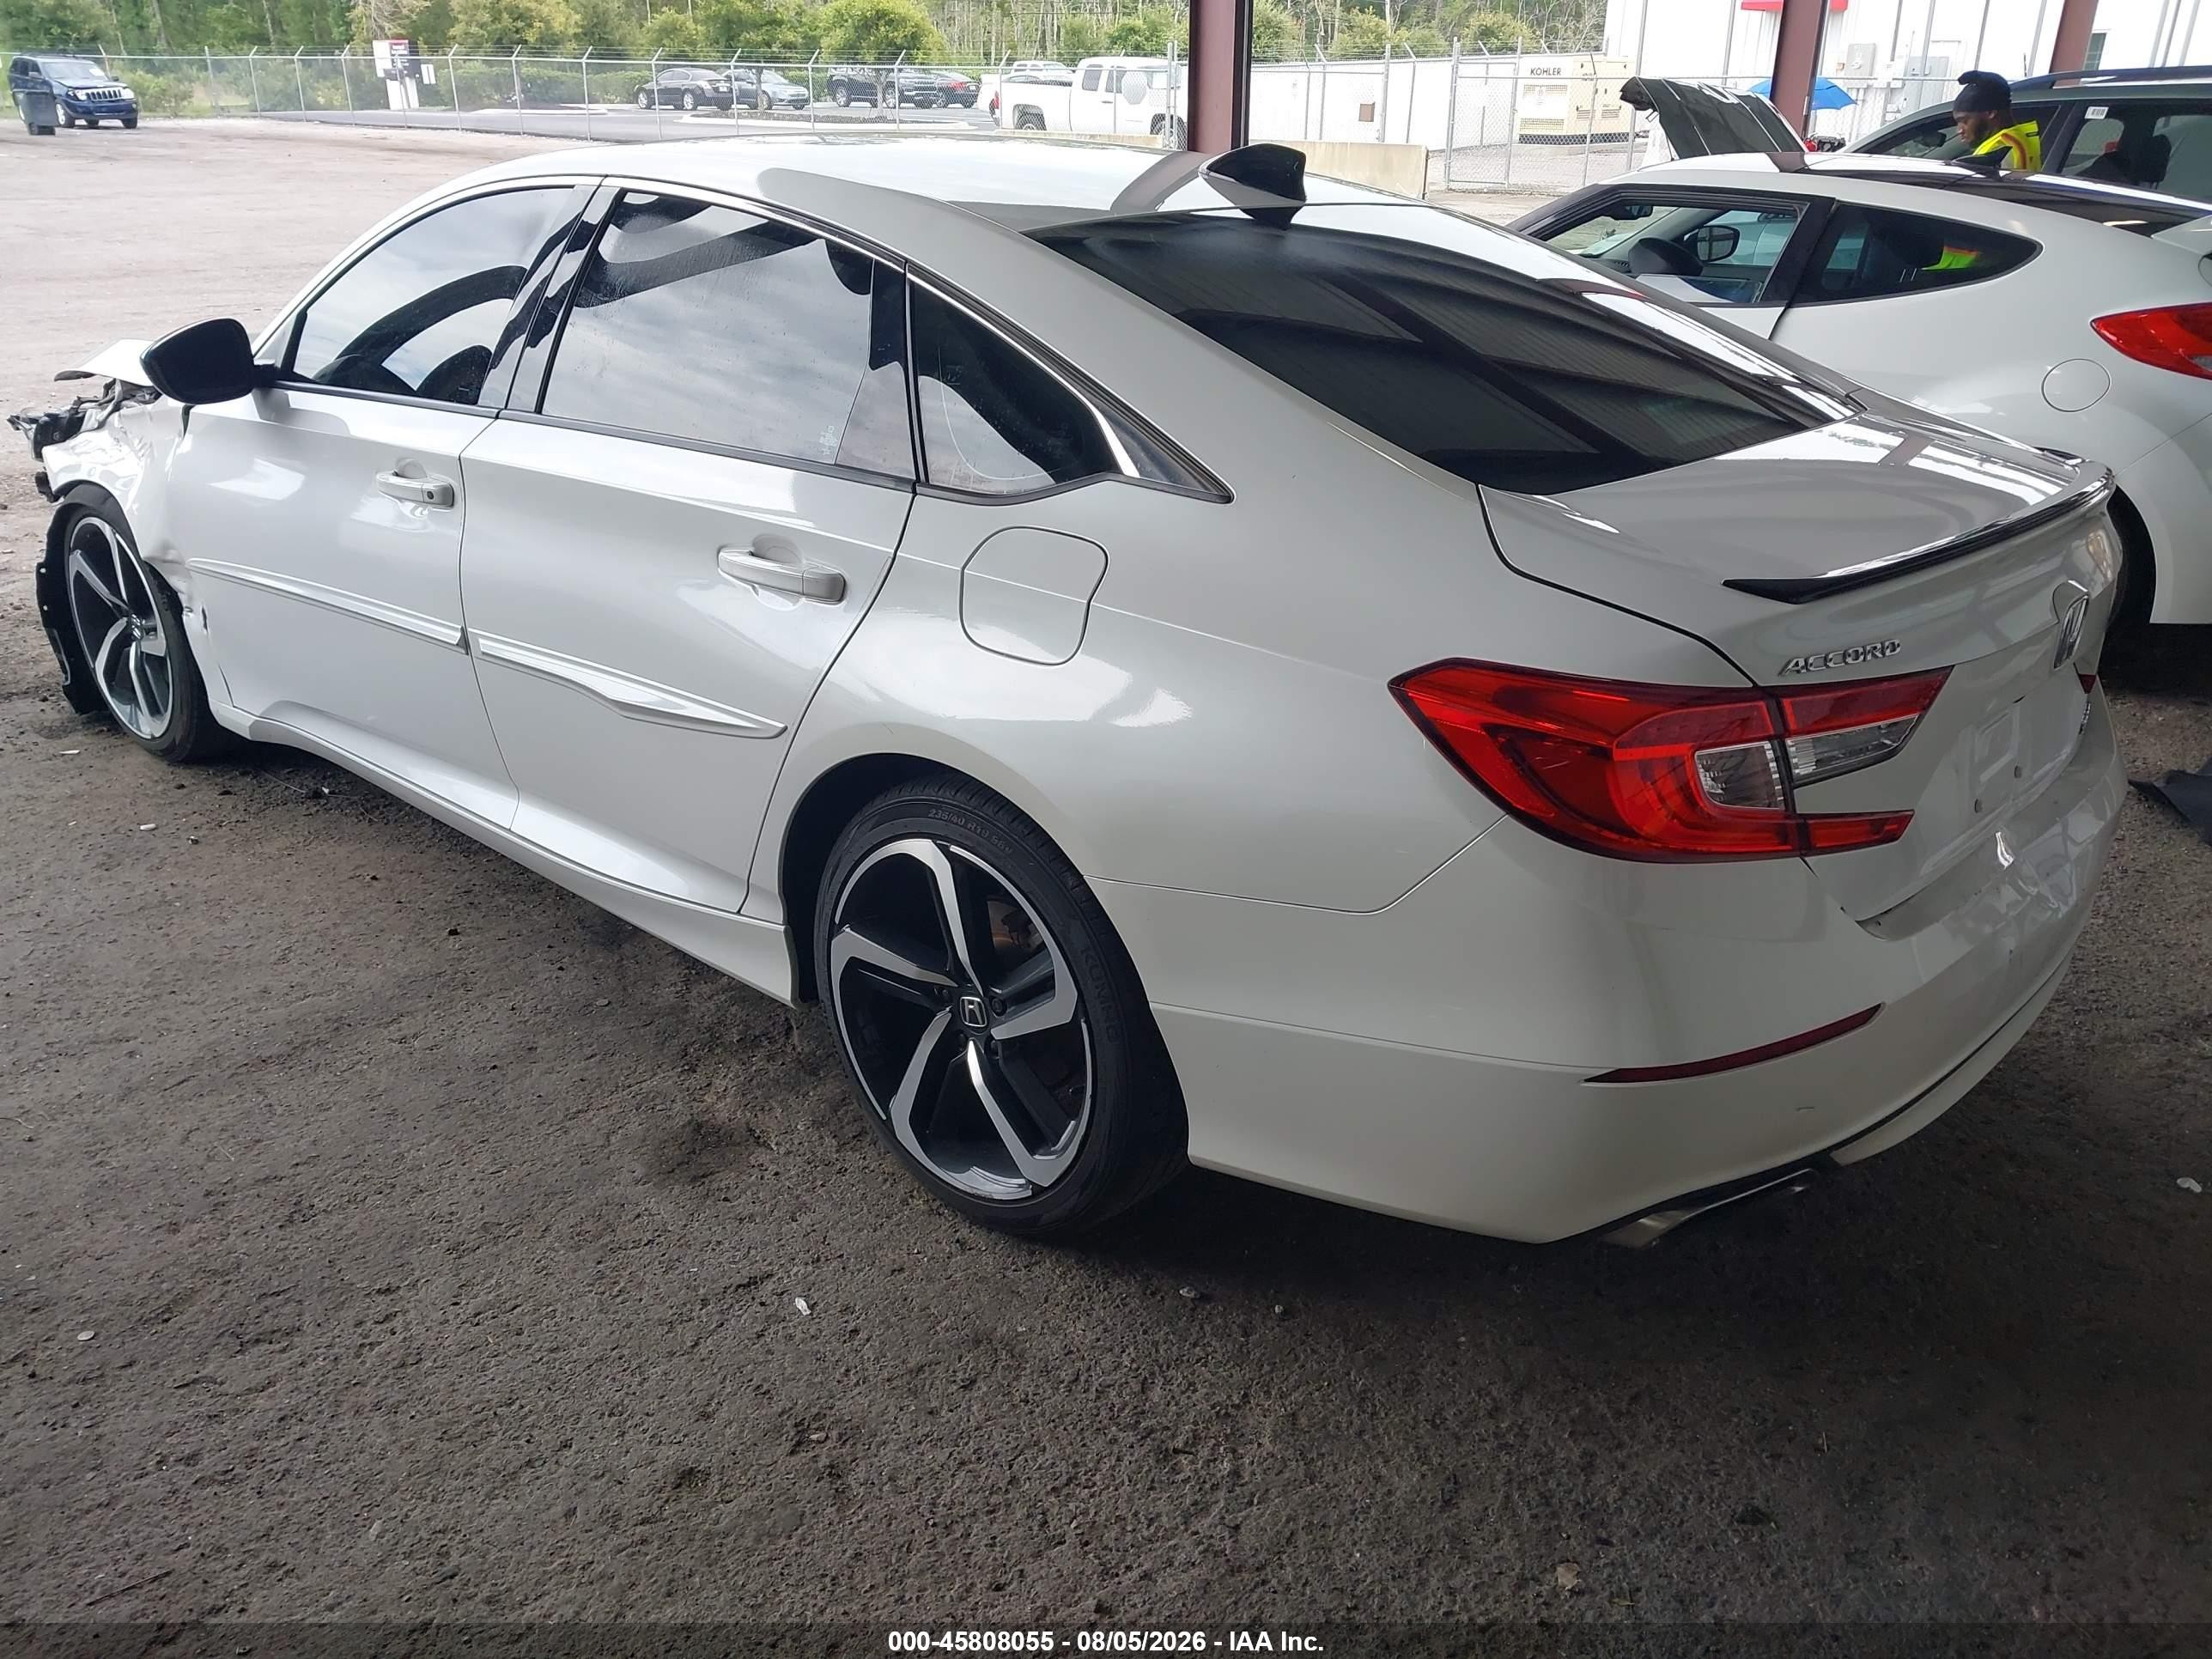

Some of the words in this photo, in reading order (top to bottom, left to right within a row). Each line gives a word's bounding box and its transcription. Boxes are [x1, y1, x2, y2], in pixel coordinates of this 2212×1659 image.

[1530, 67, 1562, 76] KOHLER
[1778, 639, 1902, 676] ACCORD
[927, 808, 965, 826] 235/40
